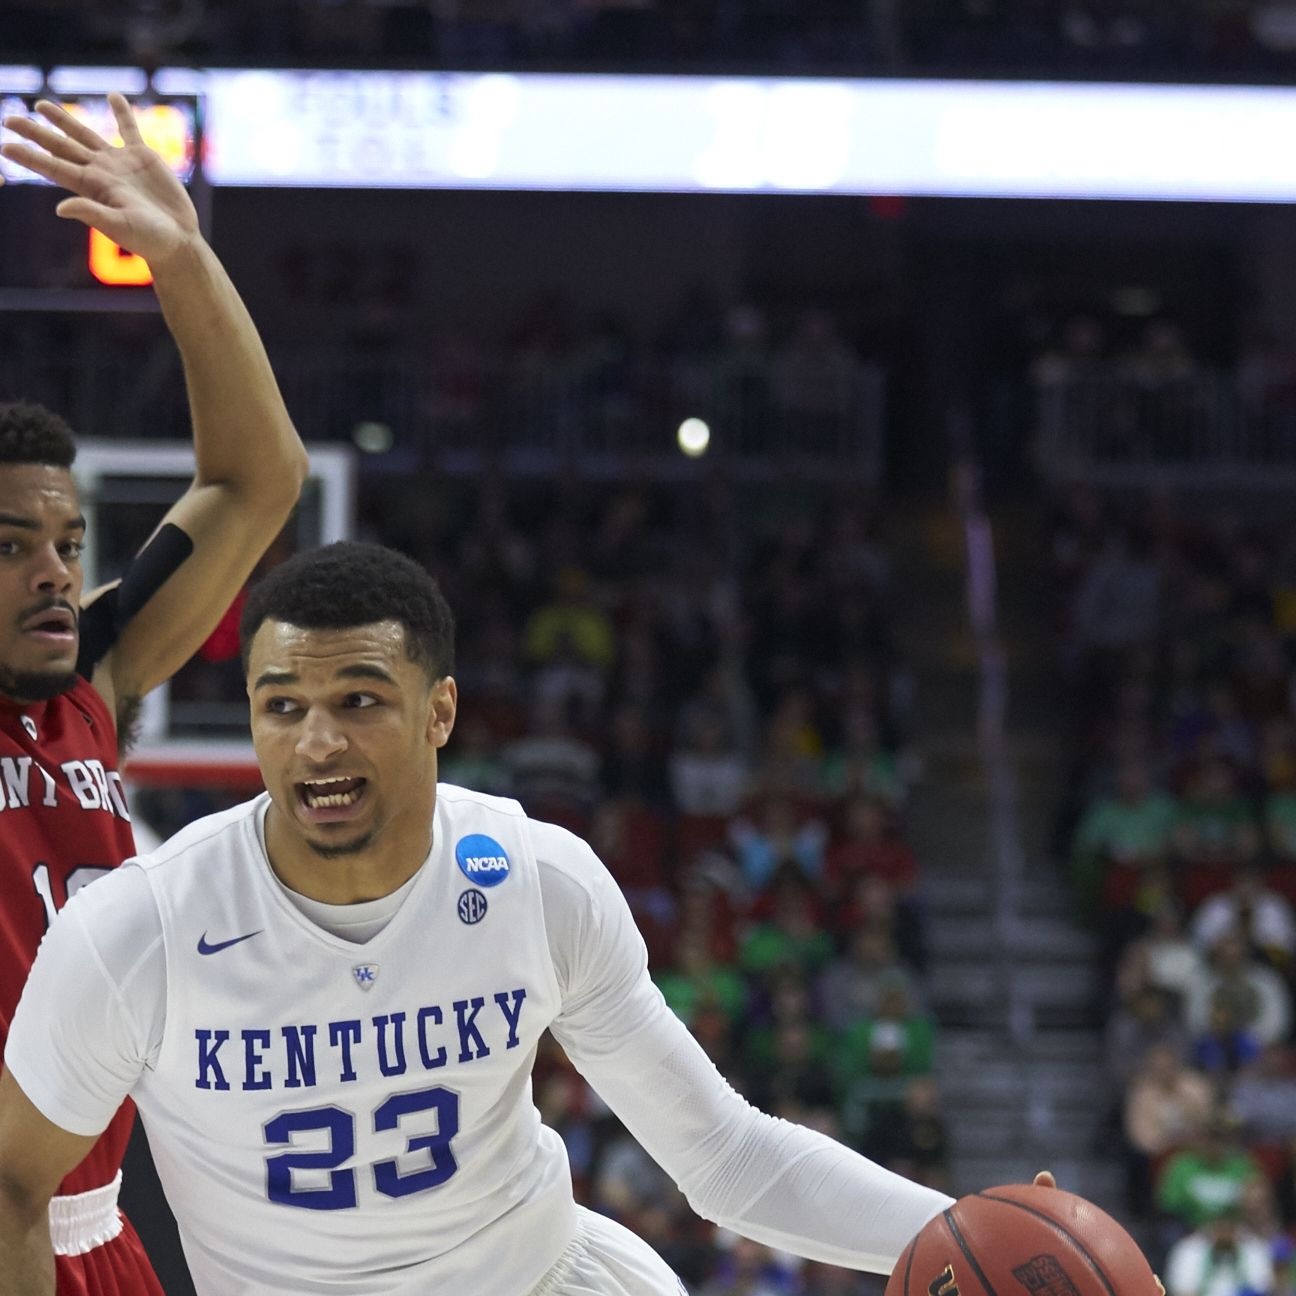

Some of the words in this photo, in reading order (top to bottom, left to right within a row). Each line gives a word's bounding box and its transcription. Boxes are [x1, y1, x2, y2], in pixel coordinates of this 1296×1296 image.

[465, 856, 509, 872] NCAA
[459, 890, 485, 923] SEC
[194, 989, 527, 1091] KENTUCKY
[261, 1084, 461, 1211] 23
